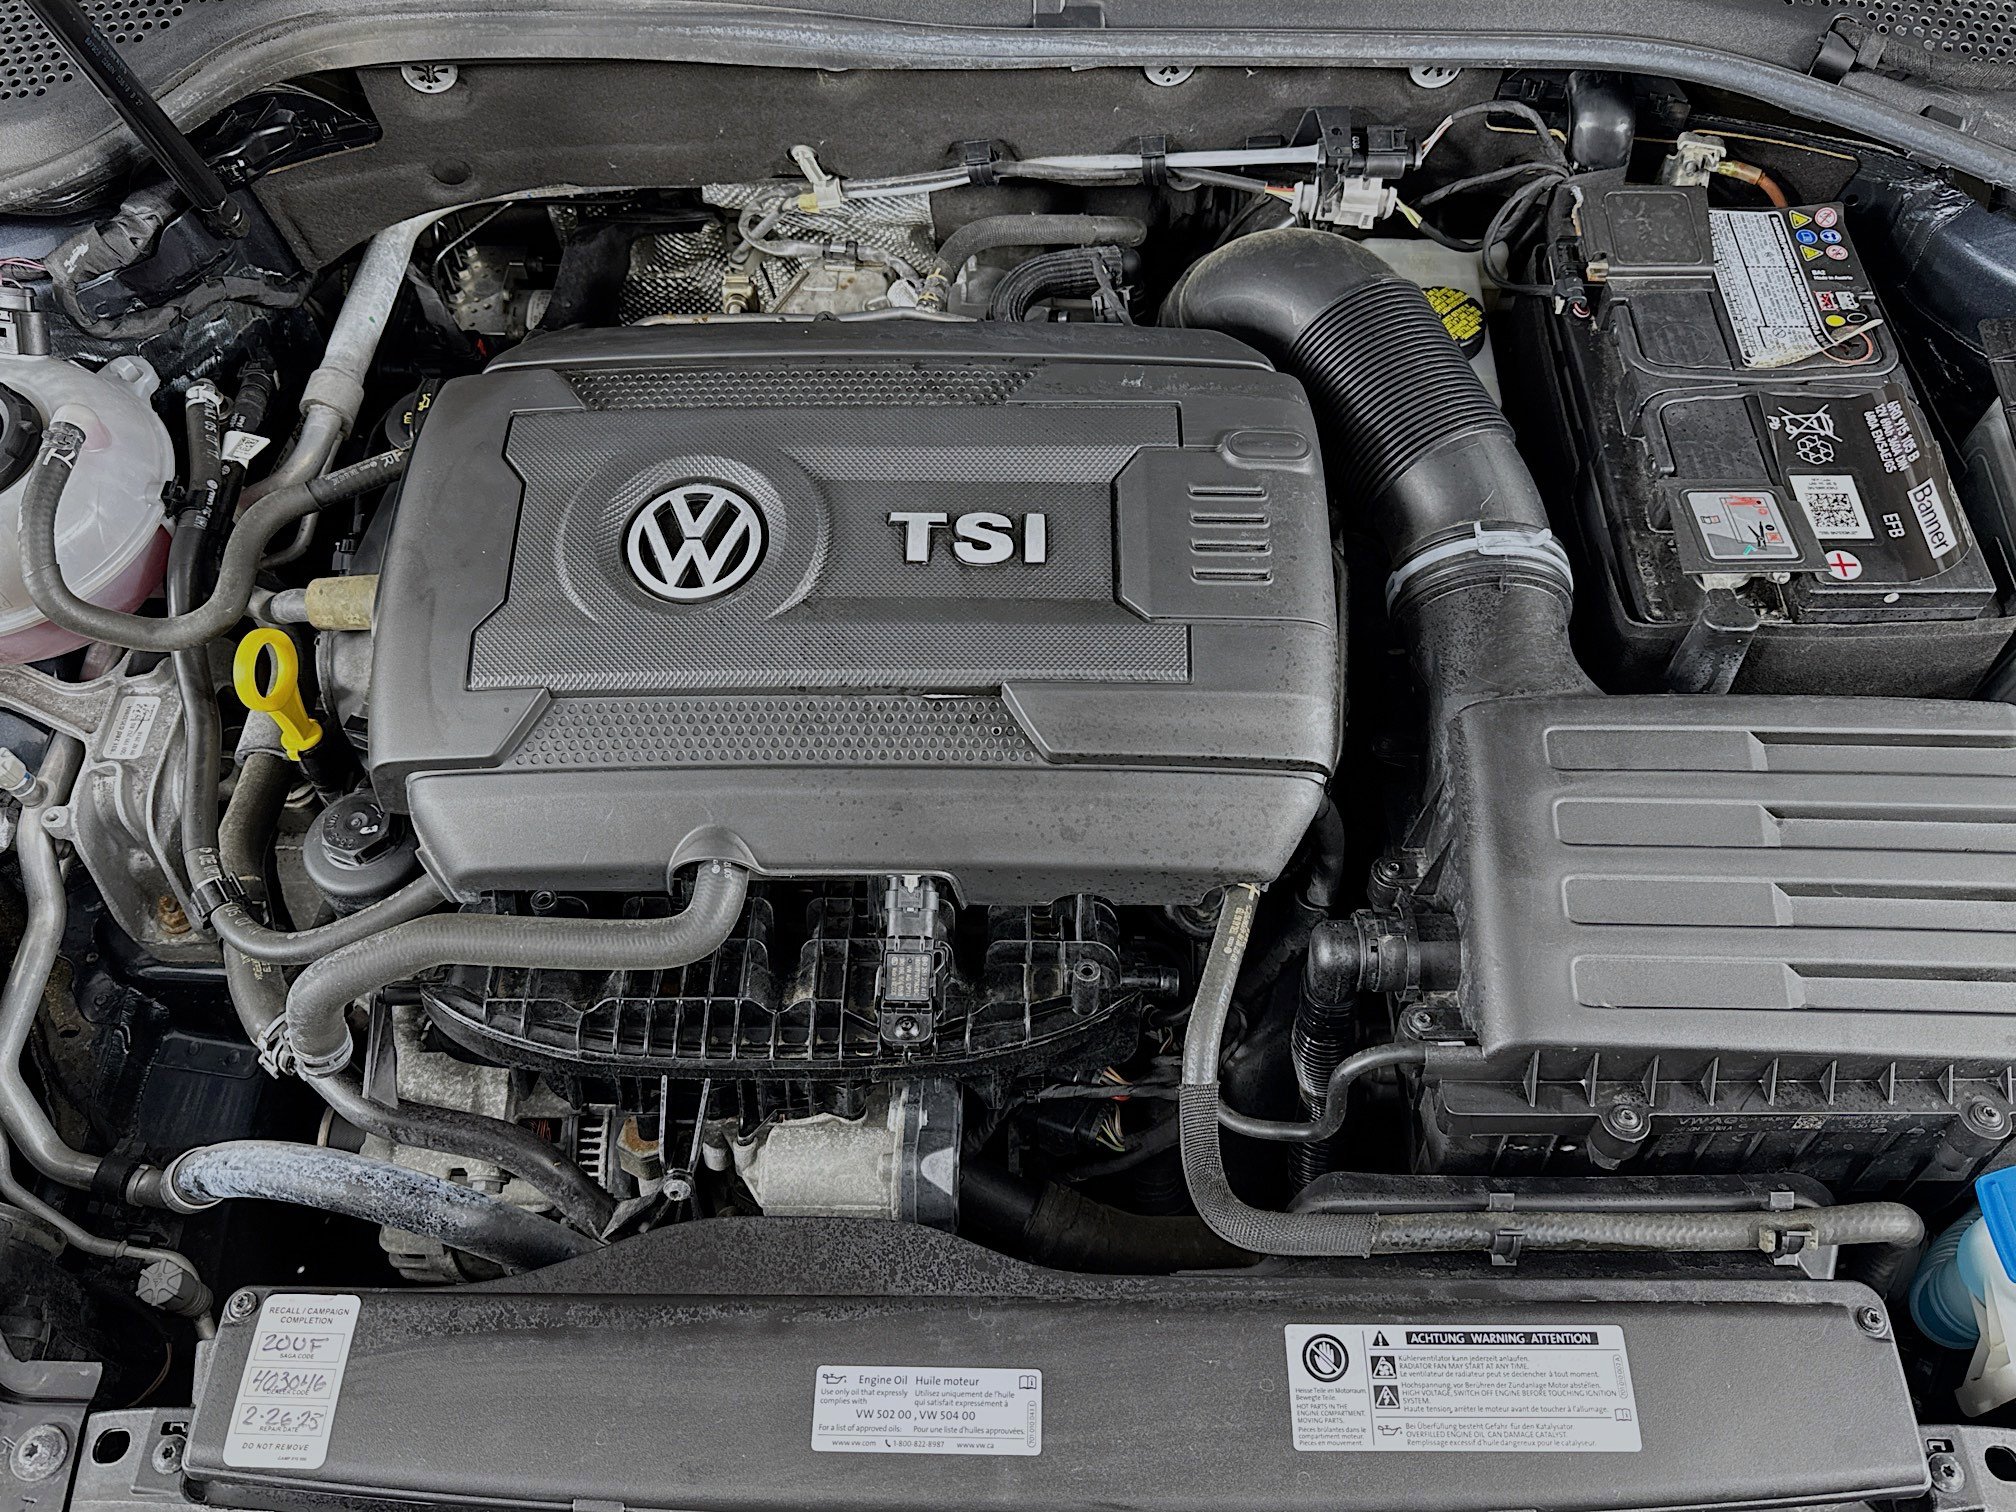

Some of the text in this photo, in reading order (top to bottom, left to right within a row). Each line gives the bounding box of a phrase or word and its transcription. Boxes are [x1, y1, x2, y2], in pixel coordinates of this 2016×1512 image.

[1894, 417, 1910, 436] 915
[1874, 403, 1889, 417] 12V
[1895, 454, 1910, 471] DIN
[1901, 434, 1917, 453] 105
[1907, 450, 1920, 462] B
[1913, 483, 1949, 549] Banner
[1882, 512, 1906, 538] EFB
[888, 512, 1047, 566] TSI
[269, 1306, 300, 1314] RECALL
[307, 1307, 350, 1316] CAMPAIGN
[280, 1316, 334, 1324] COMPLETION
[1411, 1333, 1592, 1344] ACHTUNG WARNING ATTENTION
[859, 1375, 908, 1387] Engine Oil
[915, 1376, 979, 1386] Huile moteur
[835, 1389, 849, 1397] only
[876, 1390, 908, 1398] expressly
[941, 1391, 983, 1400] uniquement
[820, 1398, 850, 1406] complies
[856, 1409, 874, 1418] VW
[877, 1409, 895, 1419] 502
[919, 1410, 938, 1419] VW
[940, 1411, 959, 1420] 504
[962, 1411, 976, 1420] 00
[856, 1424, 887, 1432] approved
[275, 1443, 310, 1451] REMOVE
[1501, 1440, 1535, 1448] dangereux
[1537, 1440, 1552, 1448] pour
